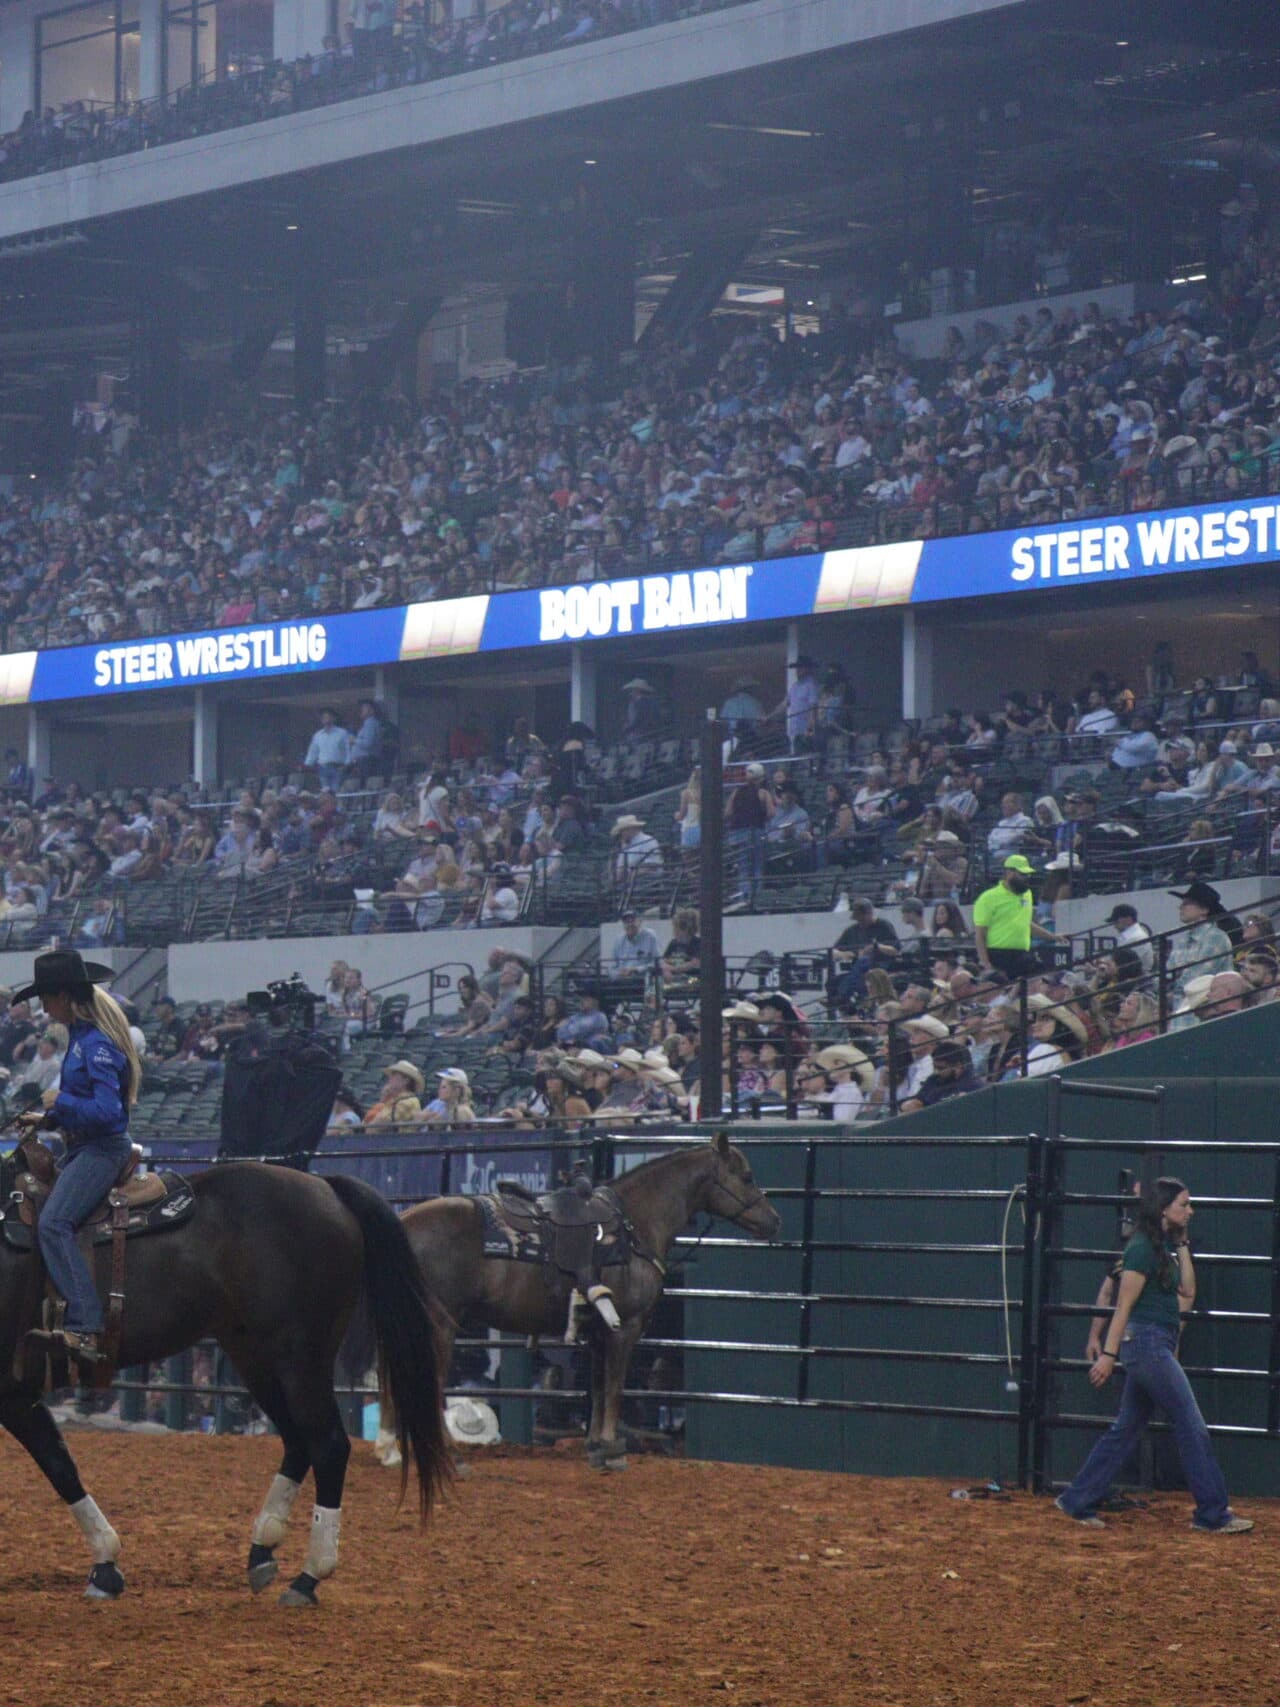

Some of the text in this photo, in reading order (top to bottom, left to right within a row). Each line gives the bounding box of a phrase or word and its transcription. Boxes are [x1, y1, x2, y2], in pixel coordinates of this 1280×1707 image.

[1011, 506, 1280, 581] STEER WREST
[539, 567, 749, 641] BOOT BARN
[95, 624, 326, 686] STEER WRESTLING
